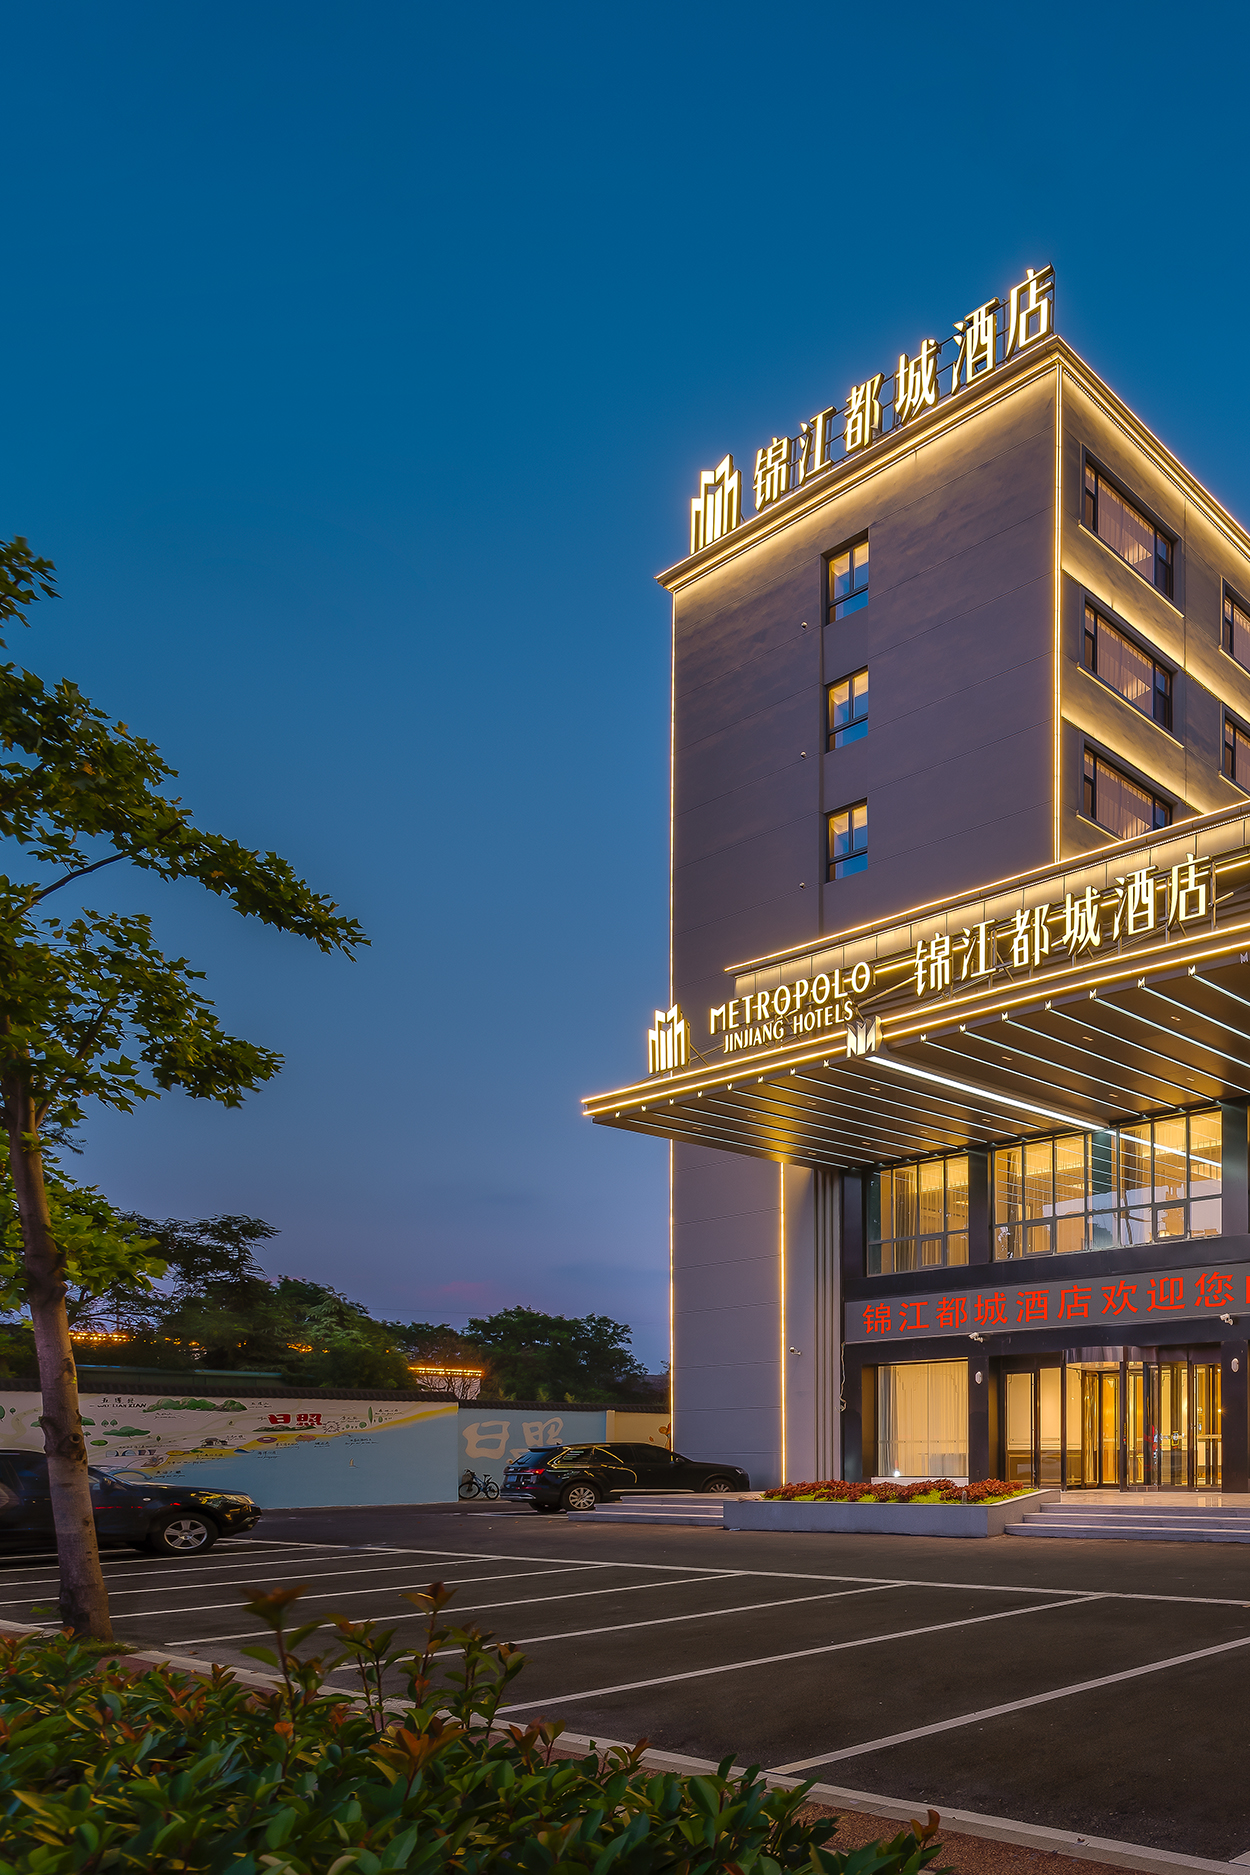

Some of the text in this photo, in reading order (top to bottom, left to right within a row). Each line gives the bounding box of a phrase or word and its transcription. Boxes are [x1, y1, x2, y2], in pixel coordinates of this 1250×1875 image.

[752, 264, 1054, 513] 锦江都城酒店
[914, 853, 1211, 997] 锦江都城酒店
[709, 961, 873, 1035] METROPOLO
[723, 1001, 853, 1054] JINJIANG HOTELS
[267, 1413, 322, 1426] 日照
